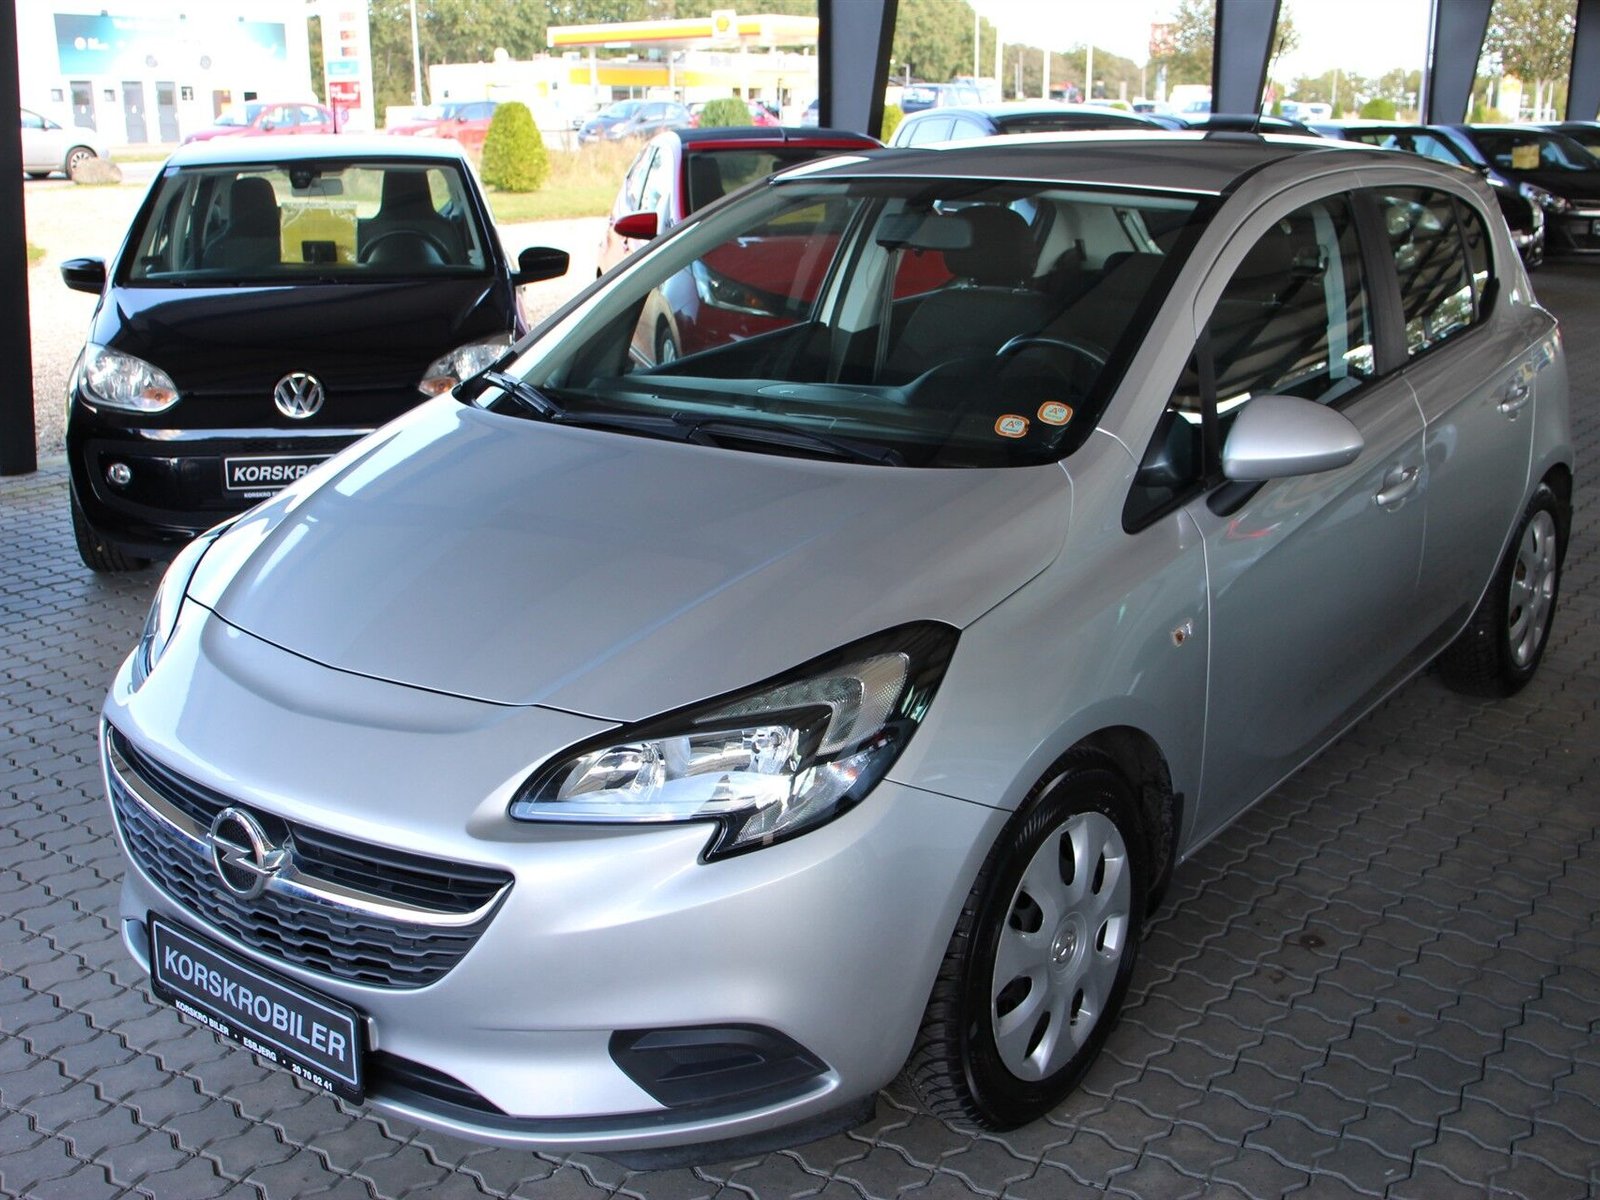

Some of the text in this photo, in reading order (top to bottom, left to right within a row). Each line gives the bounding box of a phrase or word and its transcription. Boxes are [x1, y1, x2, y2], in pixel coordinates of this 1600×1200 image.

[275, 373, 324, 418] VW
[164, 945, 347, 1062] KORSKROBILER
[175, 999, 208, 1024] KORSKRO
[208, 1017, 230, 1036] BILER
[243, 1036, 277, 1062] ESBJERG
[291, 1063, 302, 1075] 20
[323, 1080, 333, 1092] 41
